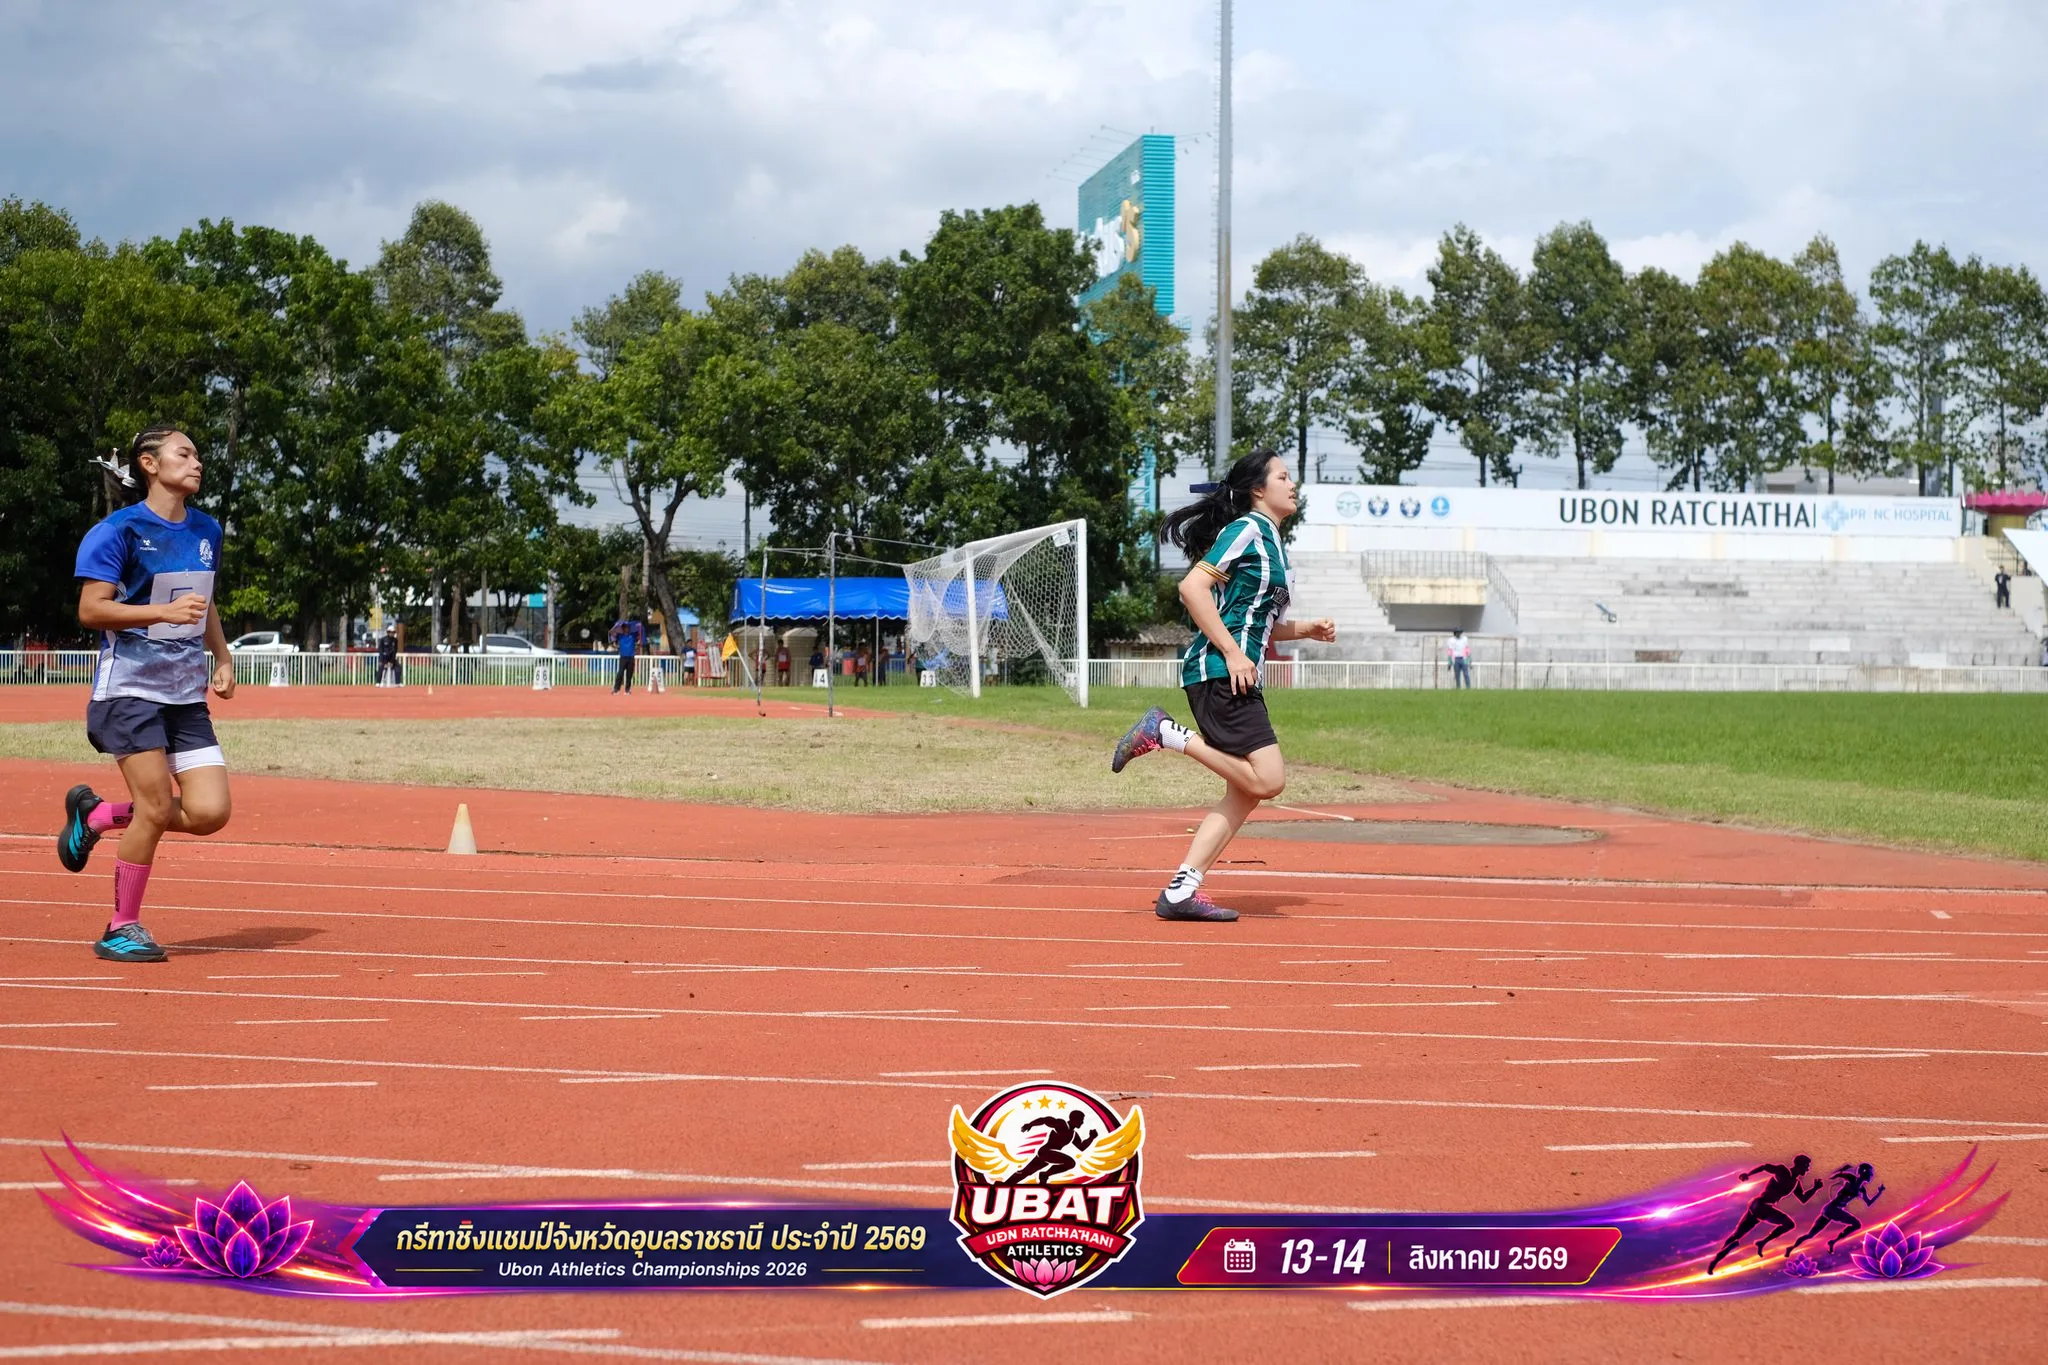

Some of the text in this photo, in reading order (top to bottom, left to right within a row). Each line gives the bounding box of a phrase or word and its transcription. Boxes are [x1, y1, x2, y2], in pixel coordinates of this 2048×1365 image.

[1559, 498, 1816, 528] UBON RATCHATHA
[1894, 509, 1952, 522] HOSPITAL
